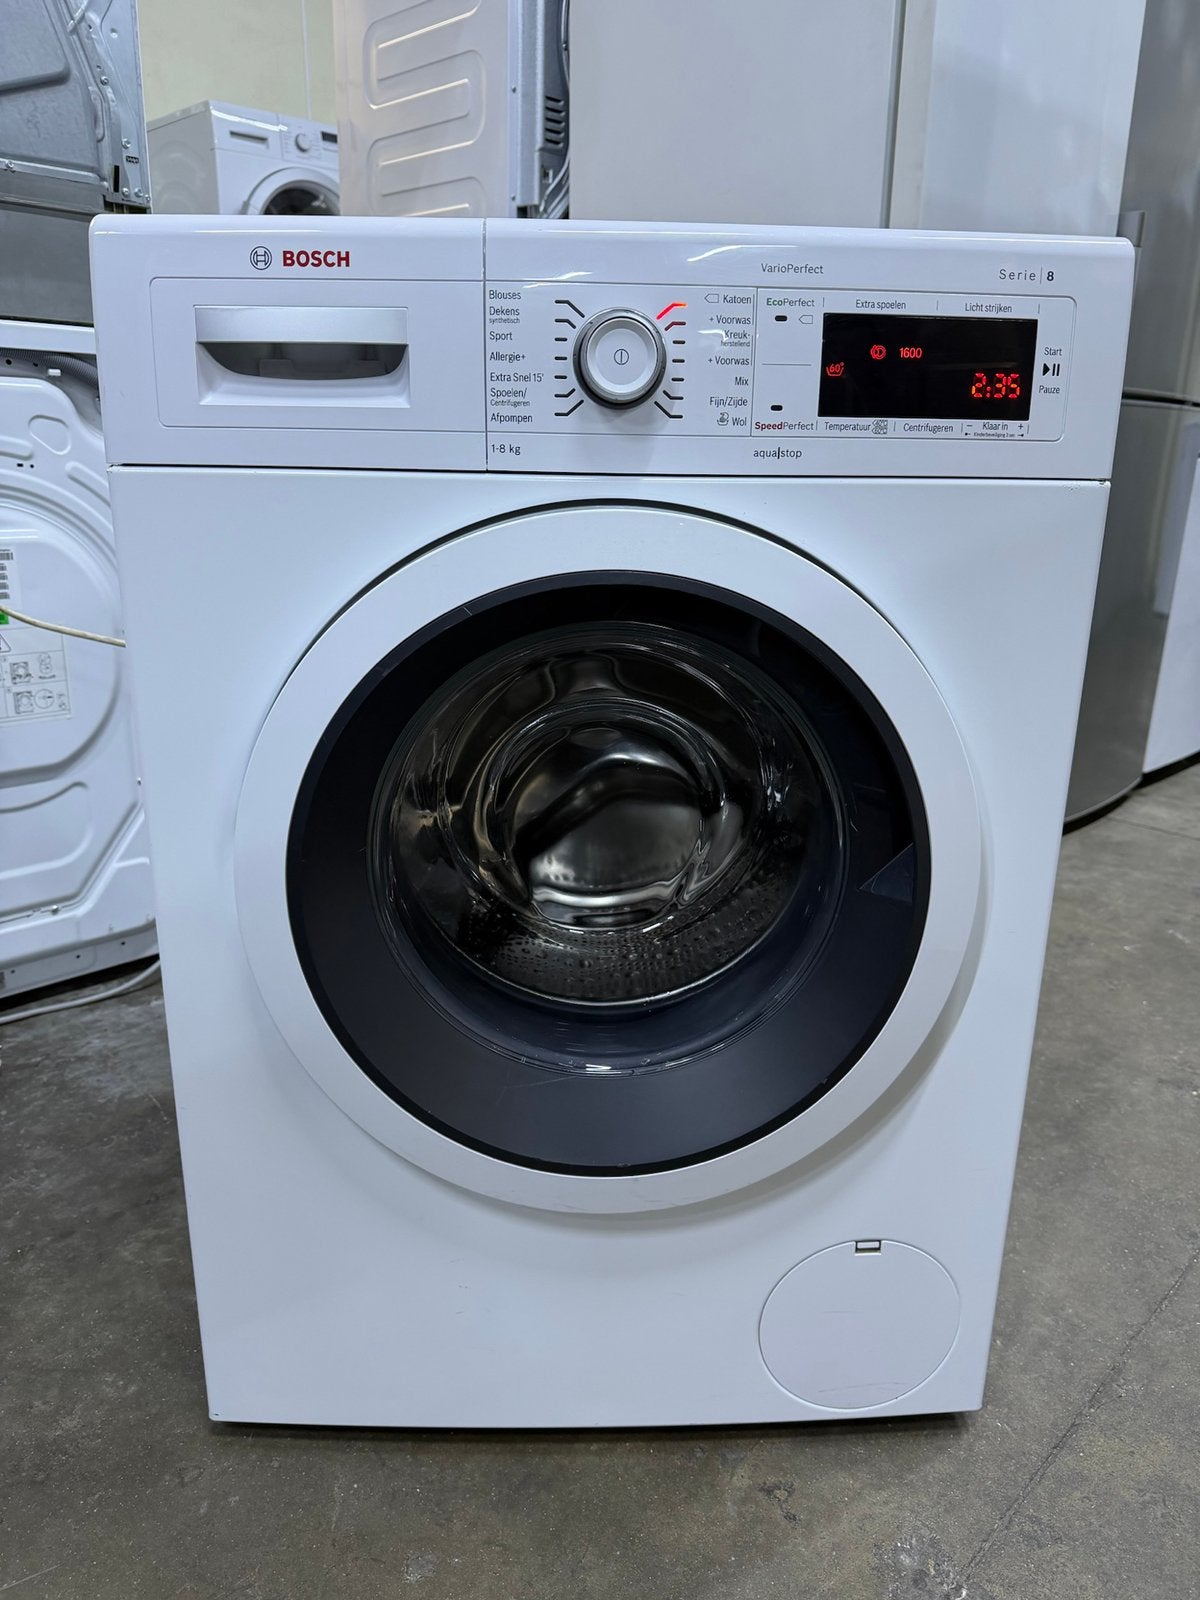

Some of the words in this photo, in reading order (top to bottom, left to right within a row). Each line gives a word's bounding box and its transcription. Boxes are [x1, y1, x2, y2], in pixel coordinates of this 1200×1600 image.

[282, 250, 350, 268] BOSCH
[761, 263, 824, 275] VarioPerfect
[999, 268, 1036, 281] Serie
[1046, 270, 1055, 282] 8
[488, 289, 522, 300] Blouses
[723, 294, 752, 305] Katoen
[766, 297, 815, 308] EcoPerfect
[855, 299, 875, 310] Extra
[876, 300, 907, 312] spoelen
[489, 306, 520, 316] Dekens
[965, 303, 984, 313] Licht
[985, 303, 1013, 315] strijken
[489, 317, 521, 325] synthetisch
[716, 315, 752, 326] Voorwas
[489, 331, 513, 342] Sport
[720, 340, 751, 348] herstellend
[489, 351, 526, 364] Allergie+
[899, 347, 923, 359] 1600
[1043, 346, 1063, 358] Start
[715, 355, 750, 366] Voorwas
[490, 372, 512, 382] Extra
[513, 373, 532, 383] Snel
[735, 376, 749, 387] Mix
[971, 372, 1021, 399] 2:35
[1038, 385, 1061, 396] Pauze
[490, 387, 528, 399] Spoelen/
[490, 399, 530, 408] Centrifugeren
[709, 396, 748, 408] Fijn/Zijde
[490, 413, 533, 424] Afpompen
[732, 417, 747, 427] Wol
[754, 421, 814, 432] SpeedPerfect
[825, 421, 871, 432] Temperatuur
[903, 423, 954, 435] Centrifugeren
[982, 421, 1001, 431] Klaar
[1001, 422, 1009, 431] in
[491, 444, 506, 454] 1-8
[509, 444, 521, 456] kg
